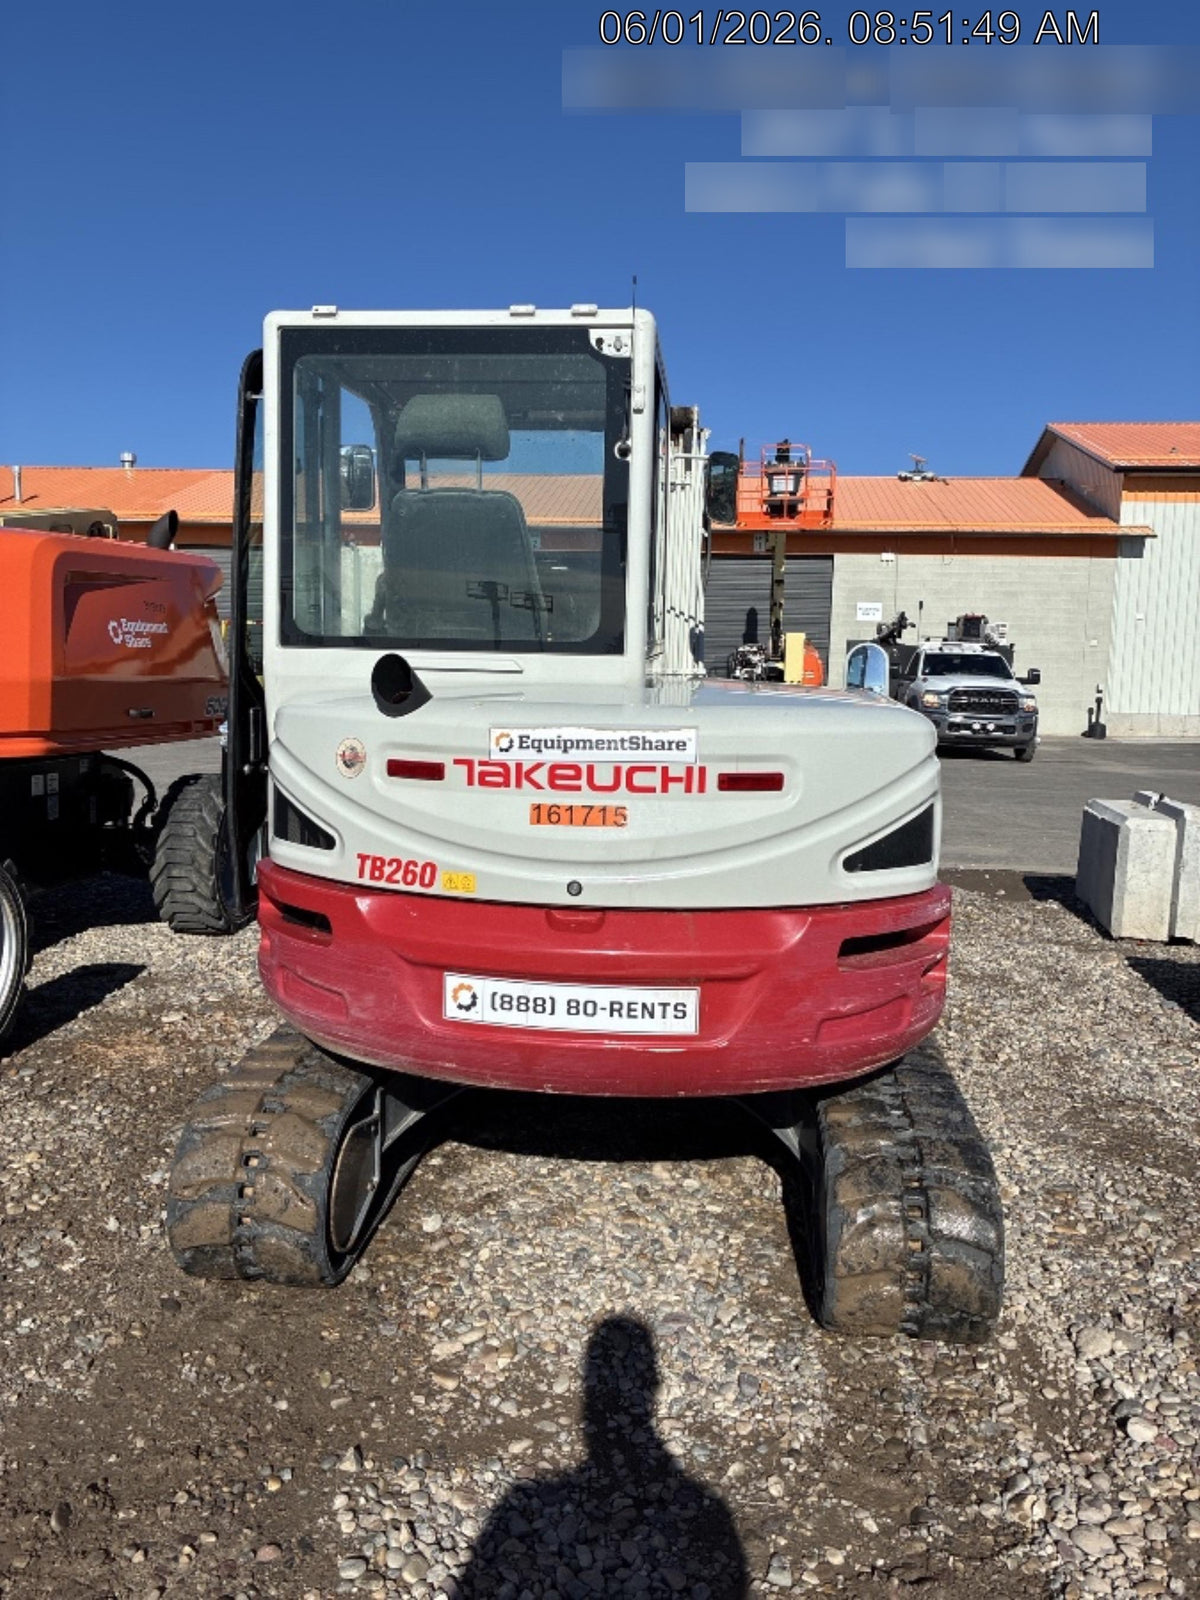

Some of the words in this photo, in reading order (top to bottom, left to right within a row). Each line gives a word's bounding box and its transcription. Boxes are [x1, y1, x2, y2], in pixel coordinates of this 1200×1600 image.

[518, 734, 688, 753] EquipmentShare
[531, 804, 628, 827] 161715
[357, 853, 438, 888] TB260
[490, 991, 556, 1016] (888)
[566, 998, 687, 1020] 80-RENTS
